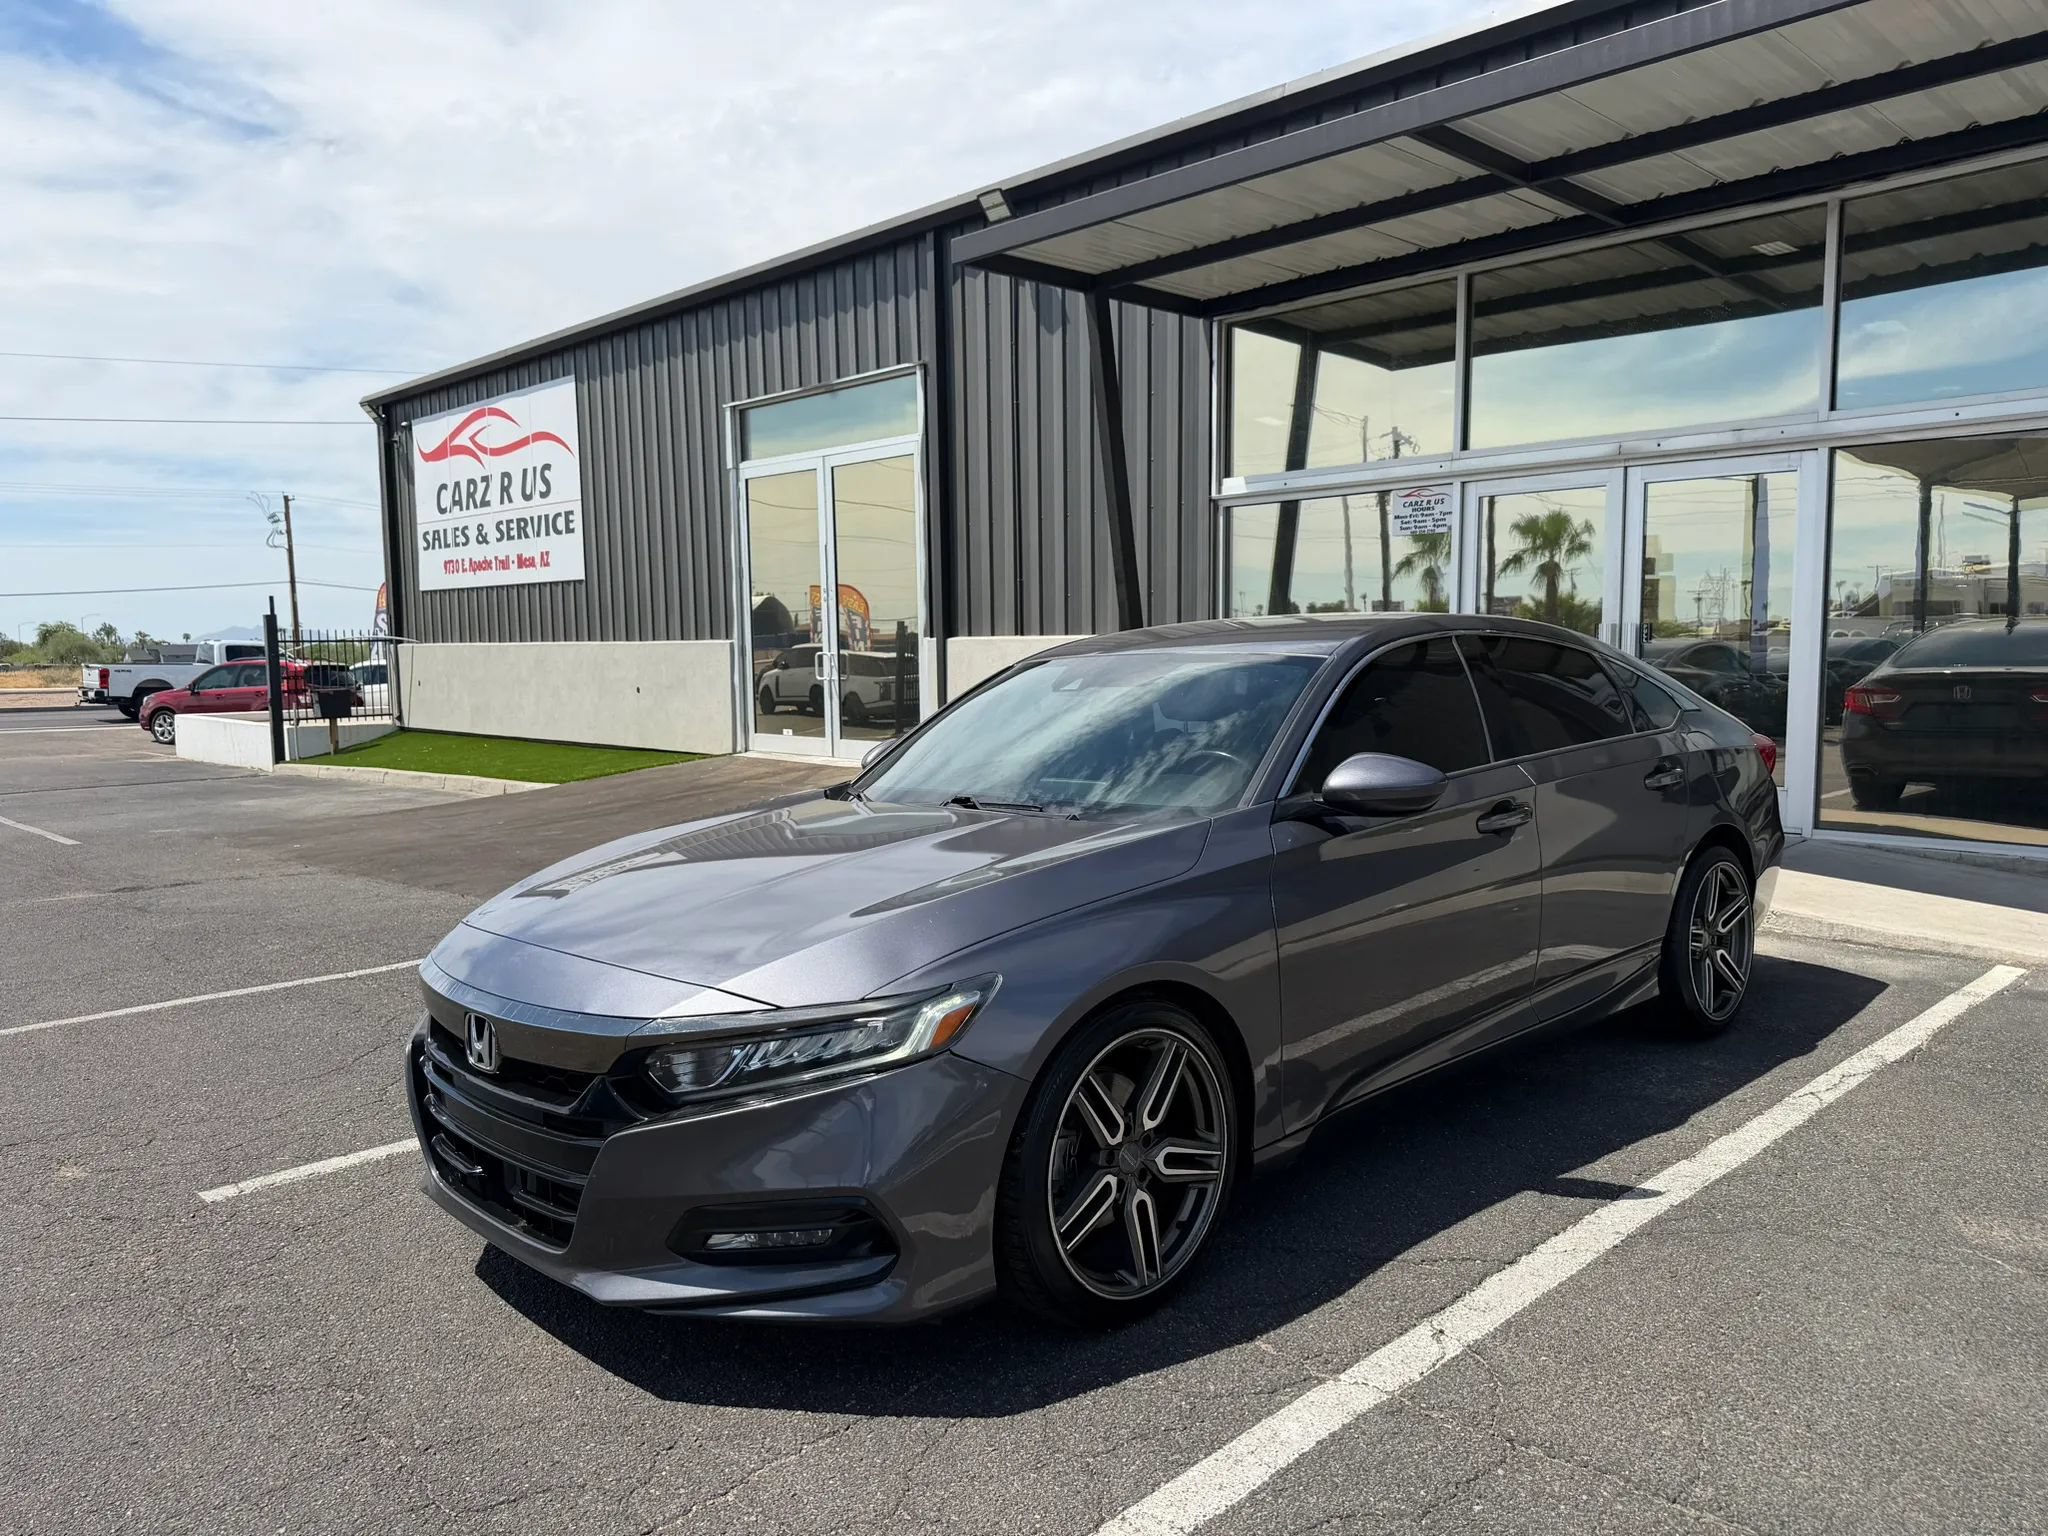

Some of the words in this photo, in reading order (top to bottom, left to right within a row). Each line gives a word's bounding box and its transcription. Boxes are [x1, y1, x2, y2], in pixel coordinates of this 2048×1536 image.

[436, 474, 492, 514] CARZ
[500, 471, 513, 505] R
[521, 463, 552, 501] US
[1403, 500, 1424, 508] CARZ
[422, 525, 470, 551] SALES
[475, 523, 490, 545] &
[495, 510, 576, 543] SERVICE
[461, 559, 468, 573] E.
[468, 556, 493, 575] Apache
[494, 555, 511, 571] Trail
[516, 553, 538, 570] Mesa,
[540, 551, 550, 567] AZ
